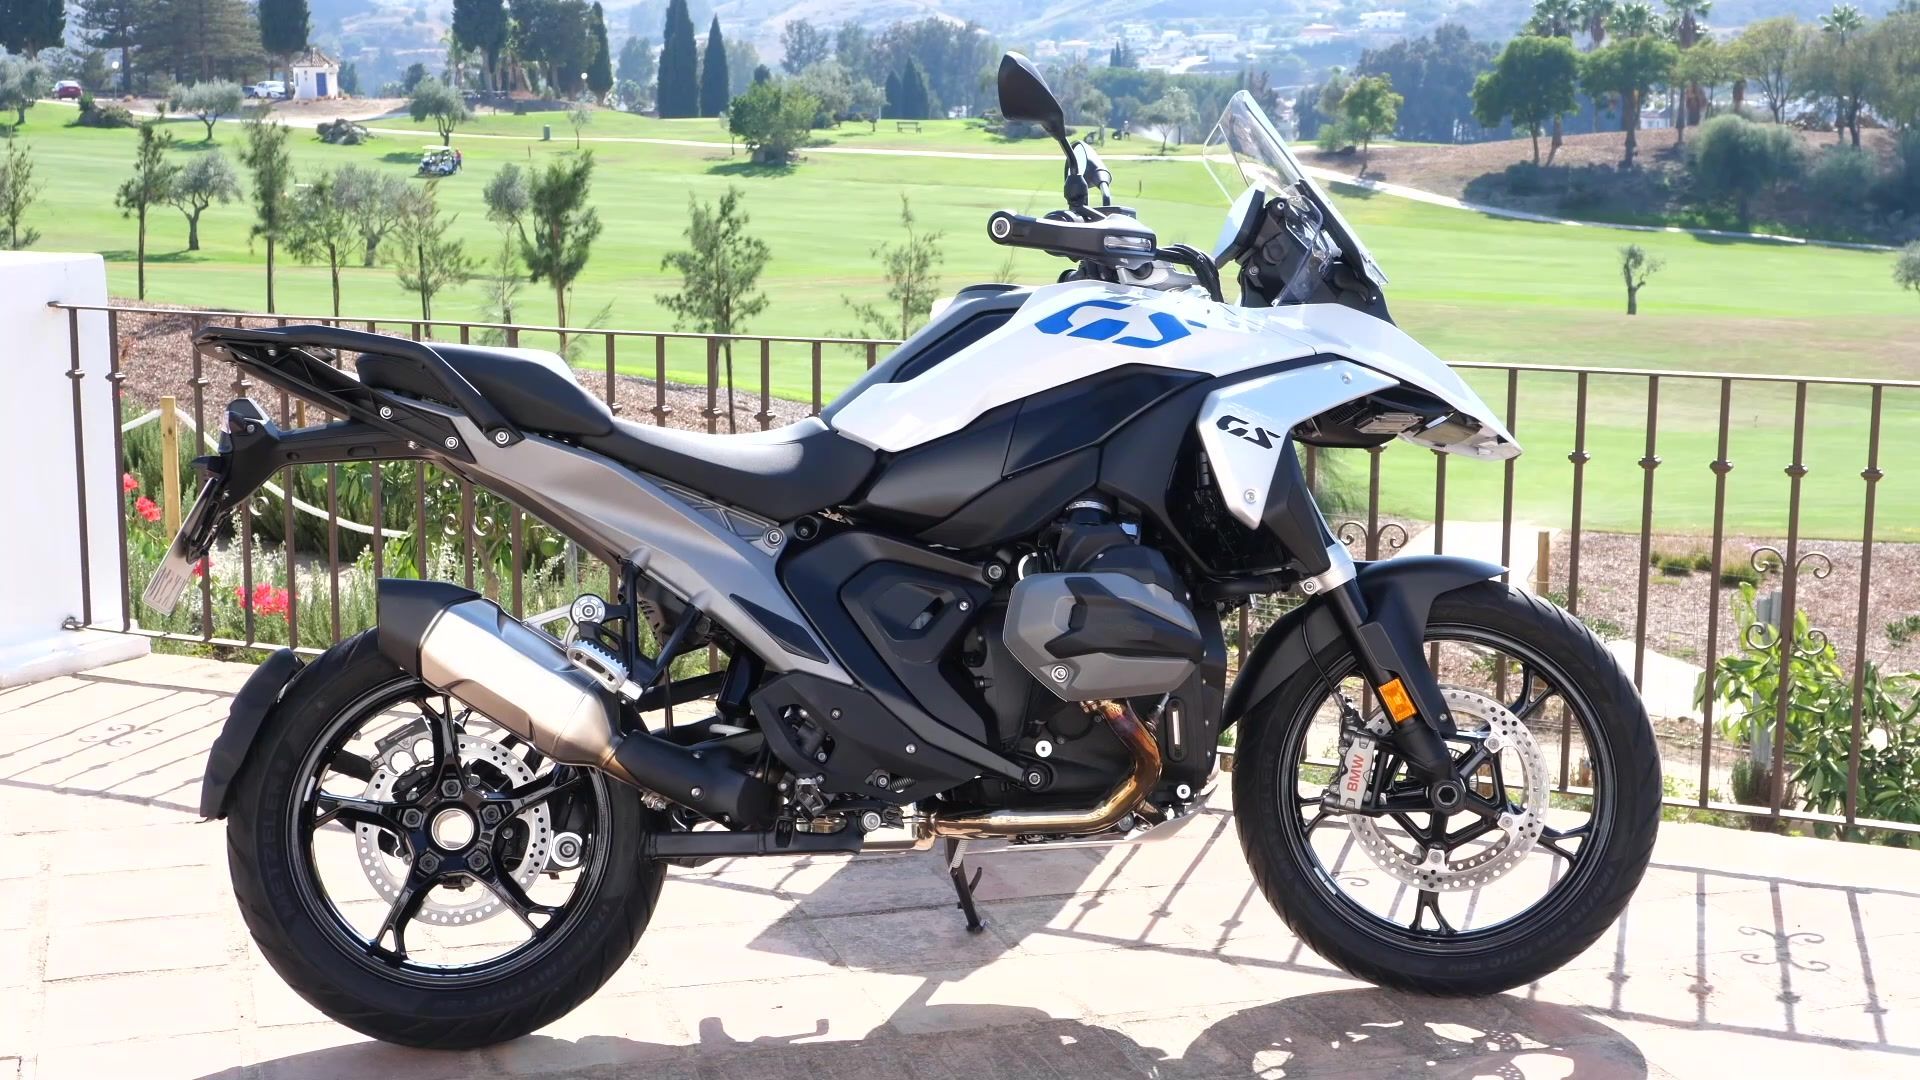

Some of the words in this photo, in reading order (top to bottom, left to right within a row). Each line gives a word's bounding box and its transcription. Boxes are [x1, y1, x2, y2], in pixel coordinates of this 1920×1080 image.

[1034, 300, 1208, 349] GS
[1216, 415, 1281, 450] GS
[1347, 754, 1364, 792] BMW
